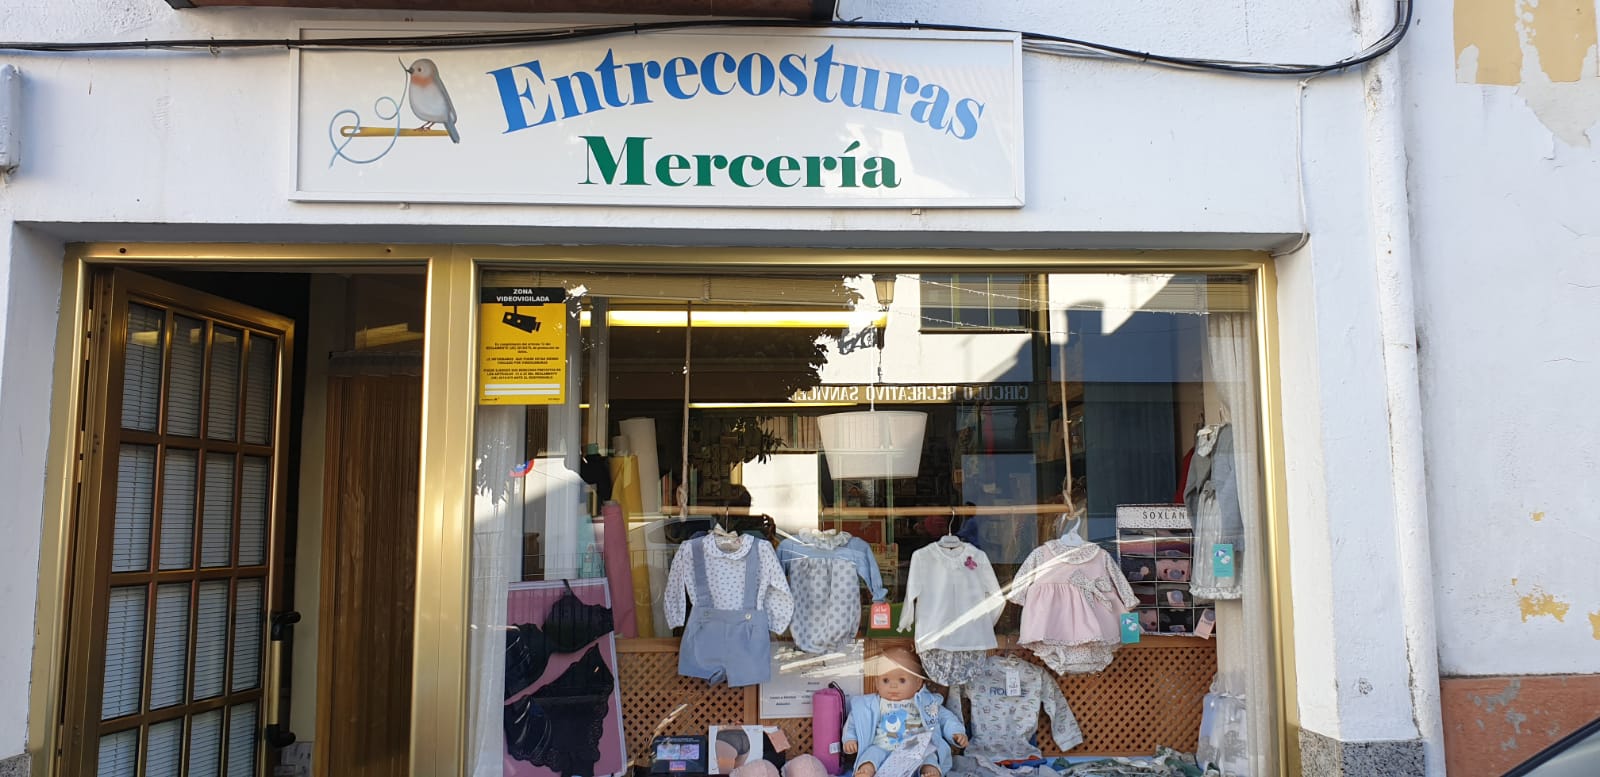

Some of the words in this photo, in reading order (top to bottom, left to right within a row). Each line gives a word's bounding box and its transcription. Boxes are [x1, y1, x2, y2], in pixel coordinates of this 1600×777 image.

[485, 44, 985, 140] Entrecosturas
[578, 135, 902, 189] Mercería
[1142, 511, 1185, 520] SOXLAN
